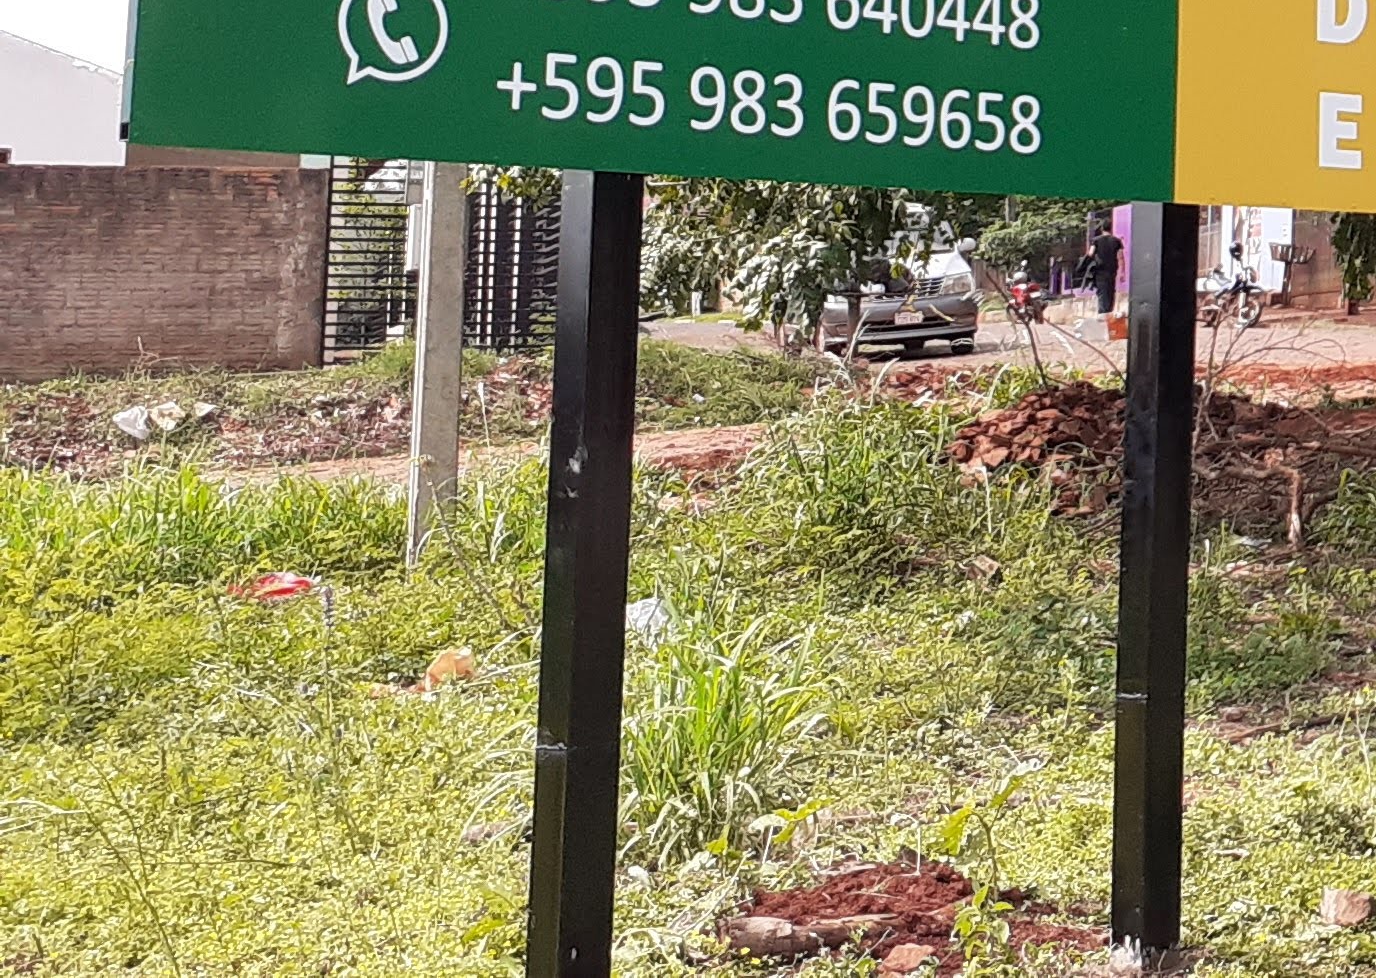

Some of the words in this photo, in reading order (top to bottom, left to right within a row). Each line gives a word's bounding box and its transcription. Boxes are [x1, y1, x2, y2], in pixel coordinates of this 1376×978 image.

[497, 53, 665, 126] +595
[690, 67, 804, 137] 983
[827, 80, 1041, 154] 659658
